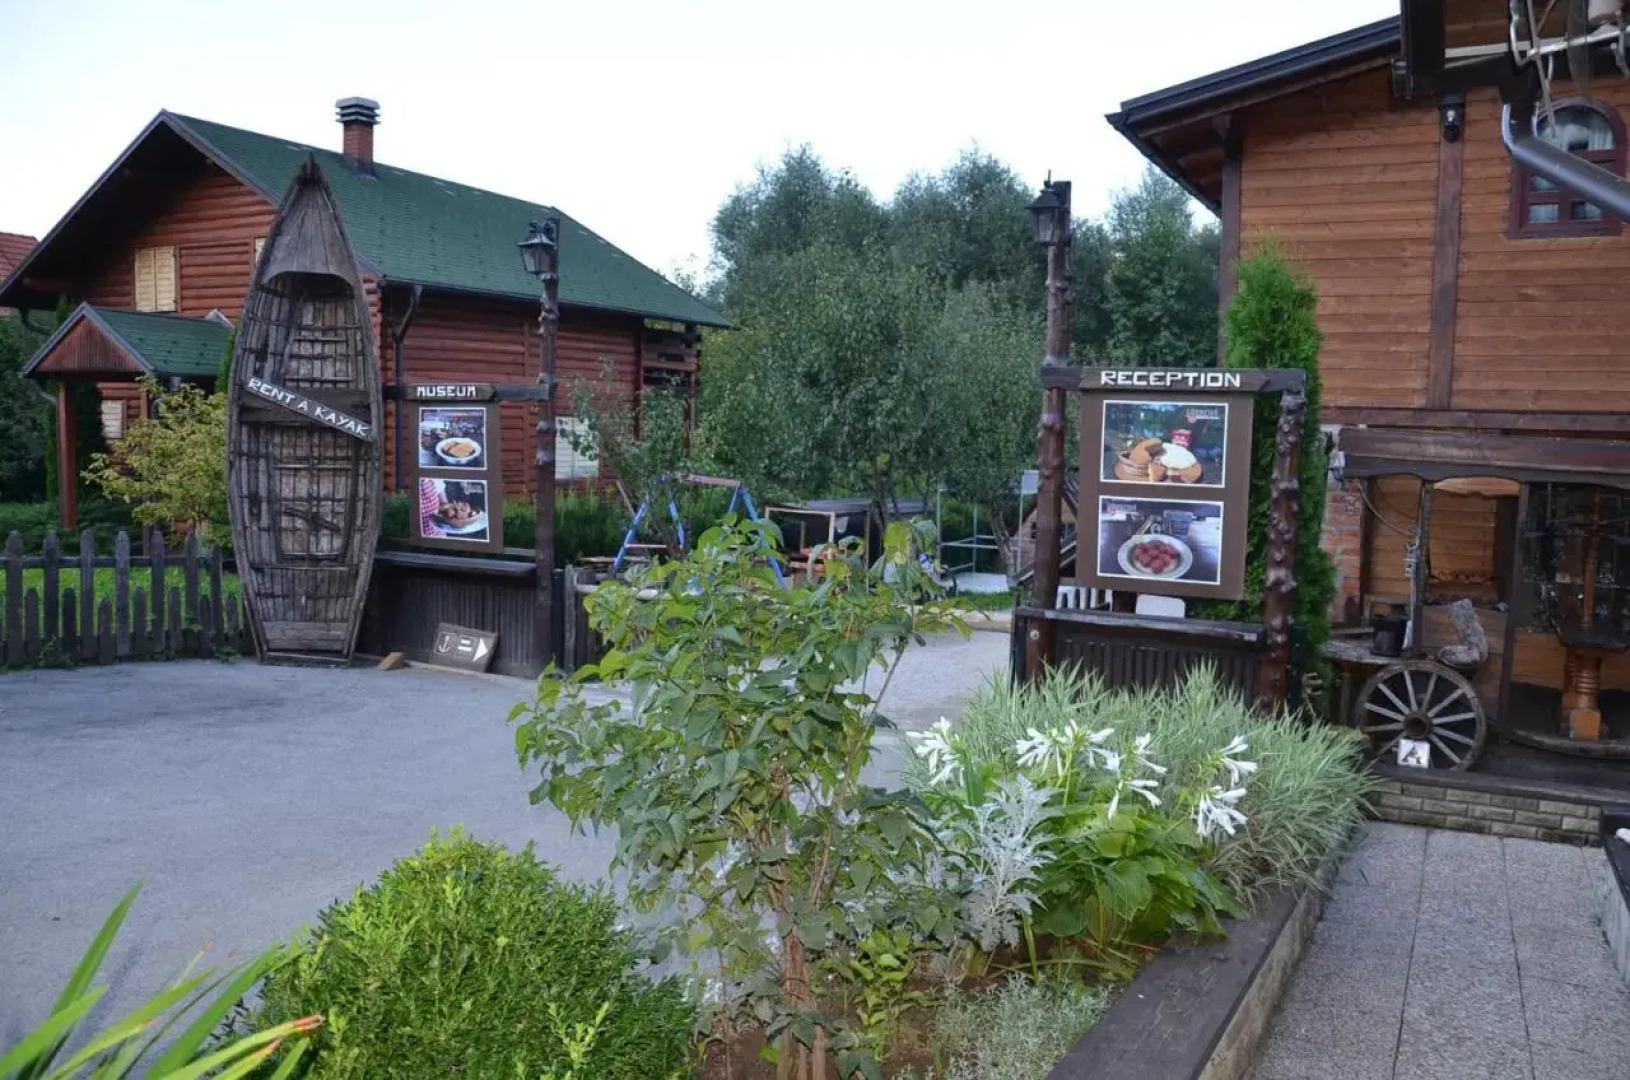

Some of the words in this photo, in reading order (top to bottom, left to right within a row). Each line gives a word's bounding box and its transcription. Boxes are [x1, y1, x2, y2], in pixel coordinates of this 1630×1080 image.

[1100, 370, 1241, 388] RECEPTION
[416, 385, 476, 398] MUSEUM
[248, 378, 295, 404] RENT
[297, 400, 308, 412] A
[315, 406, 369, 437] KAYAK
